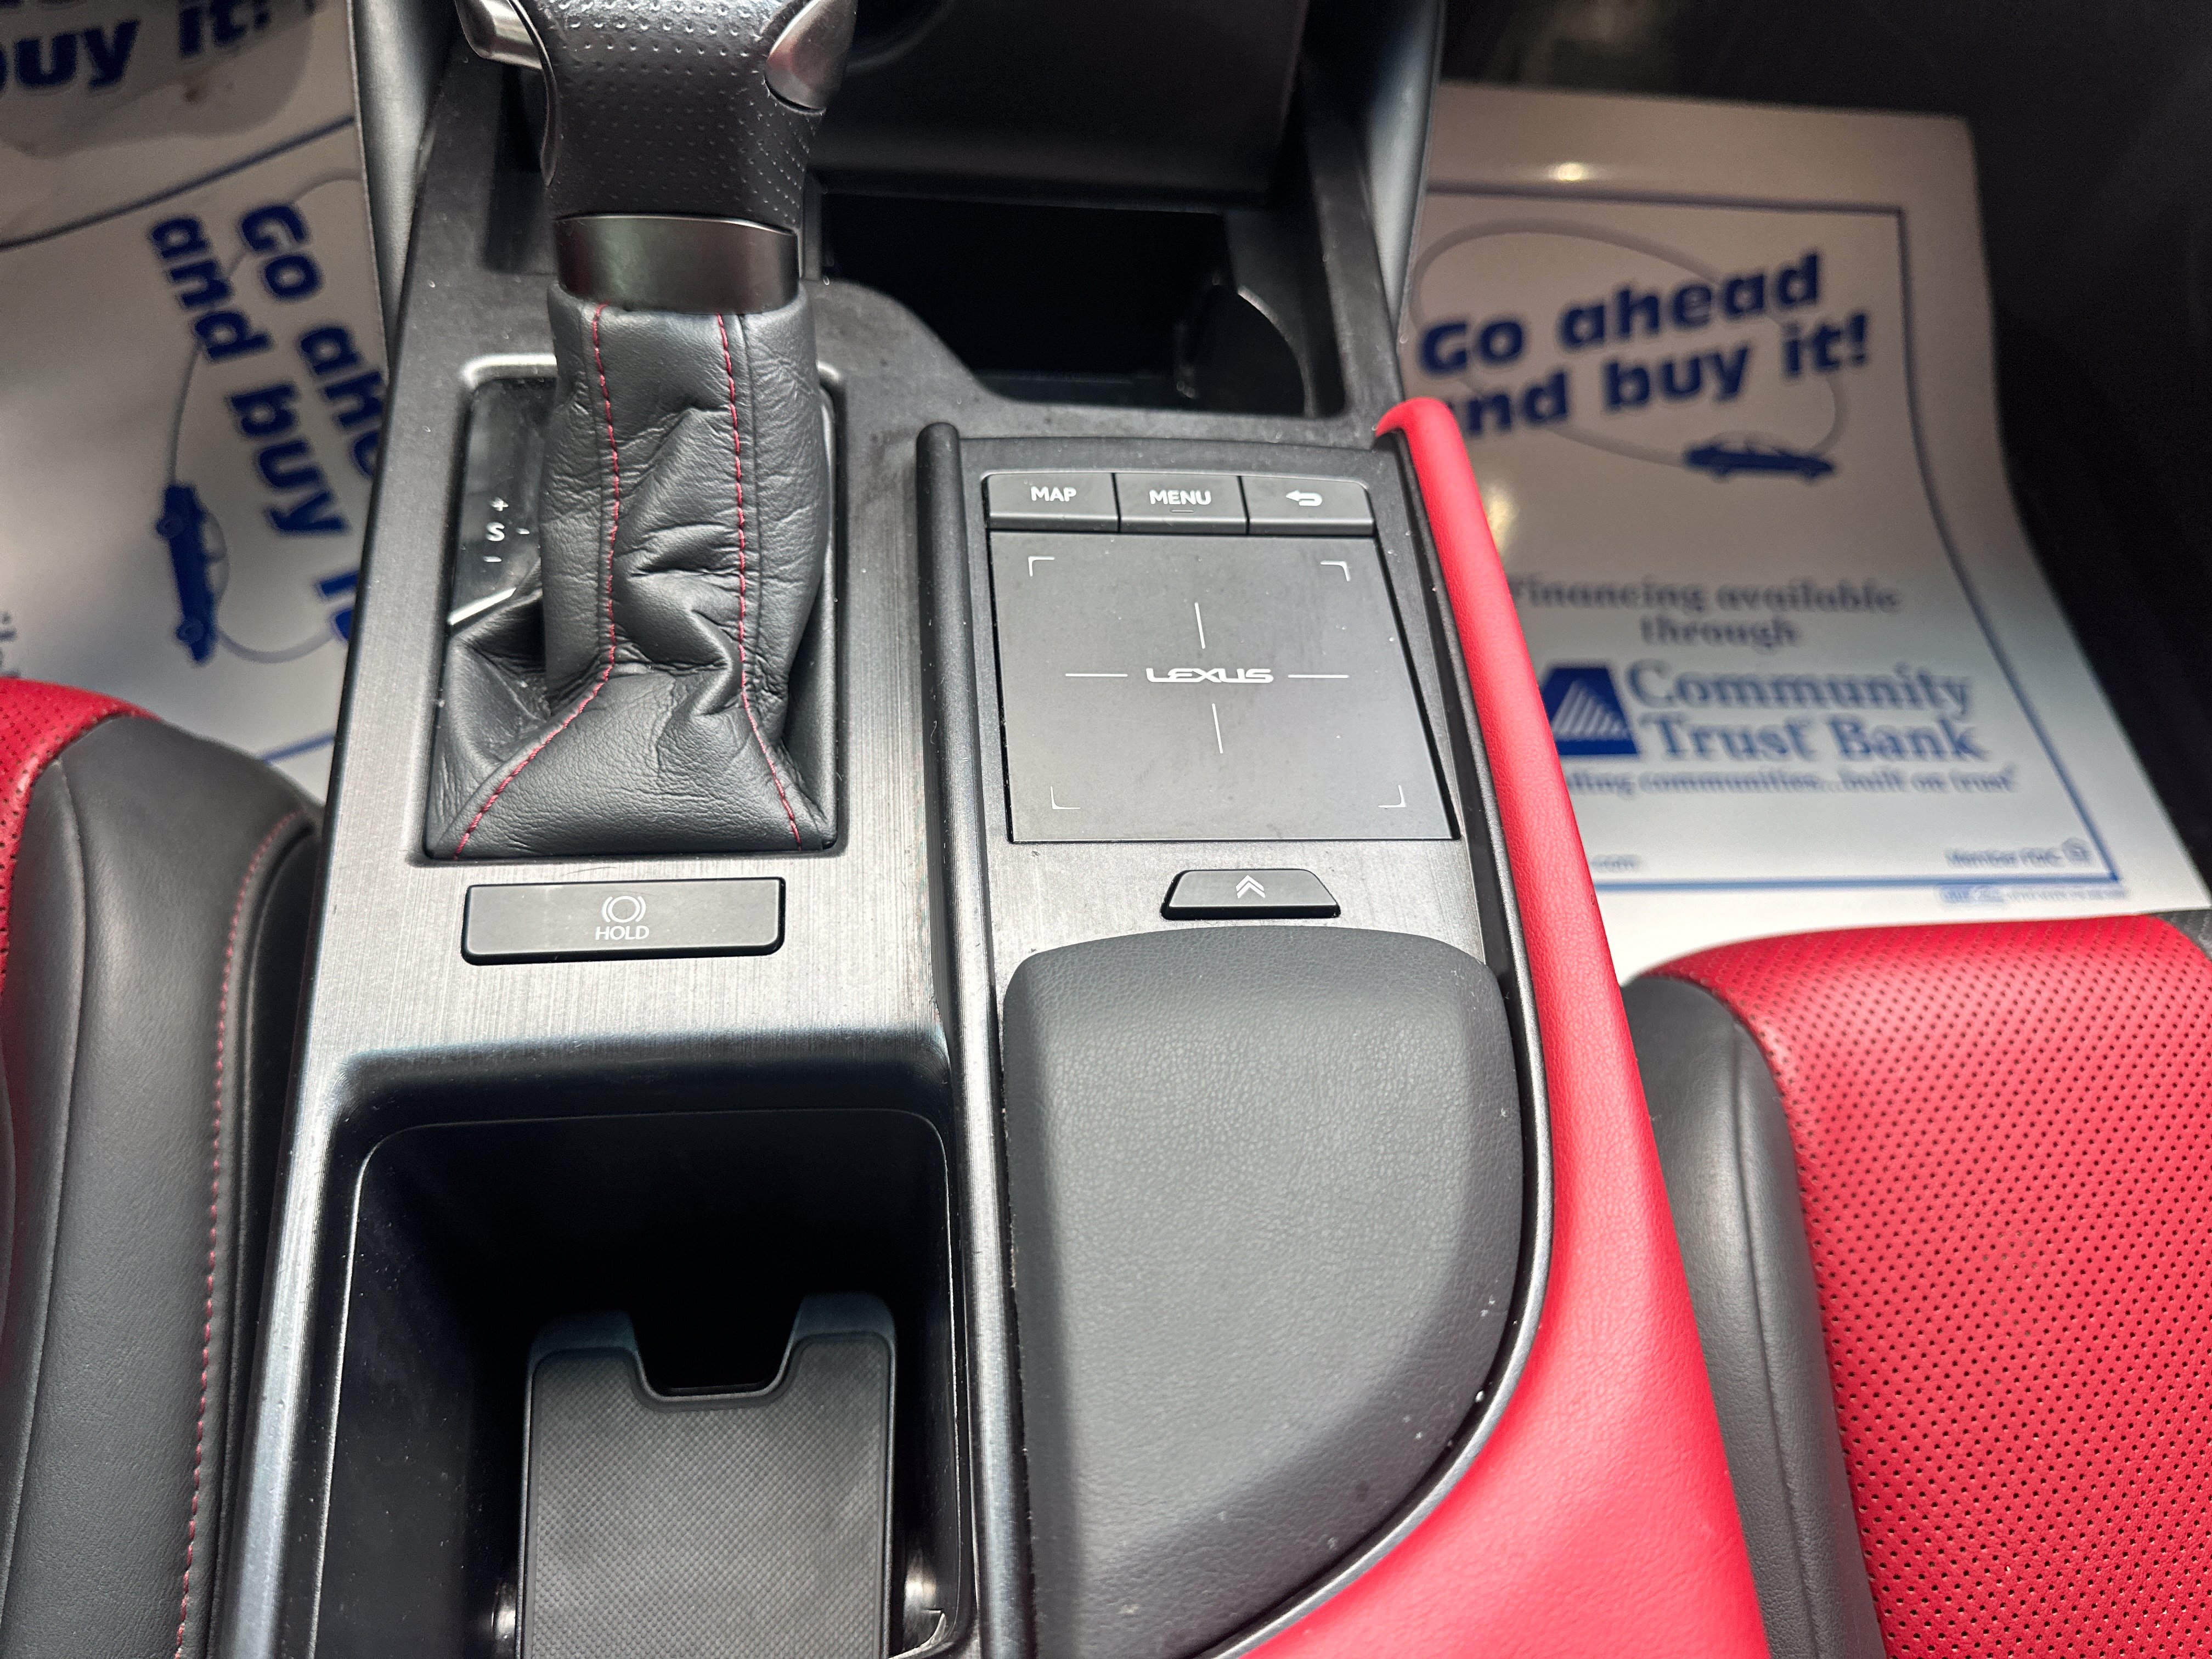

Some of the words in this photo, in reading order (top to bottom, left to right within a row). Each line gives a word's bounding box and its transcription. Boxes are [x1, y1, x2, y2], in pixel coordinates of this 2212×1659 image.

[0, 16, 140, 91] uy
[238, 201, 325, 300] Go
[1417, 316, 1525, 376] Go
[1558, 248, 1822, 351] ahead
[147, 214, 273, 363] and
[225, 380, 349, 535] buy
[1447, 368, 1570, 437] nd
[1603, 343, 1751, 411] buy
[1782, 311, 1870, 379] it!
[1030, 486, 1077, 503] MAP
[1149, 489, 1212, 506] MENU
[486, 521, 505, 541] S
[1638, 611, 1802, 655] through
[1146, 667, 1274, 684] LEXUS
[1625, 658, 1975, 723] Community
[1639, 712, 1817, 763] Trust
[1826, 714, 1993, 763] Bank
[595, 926, 650, 940] HOLD
